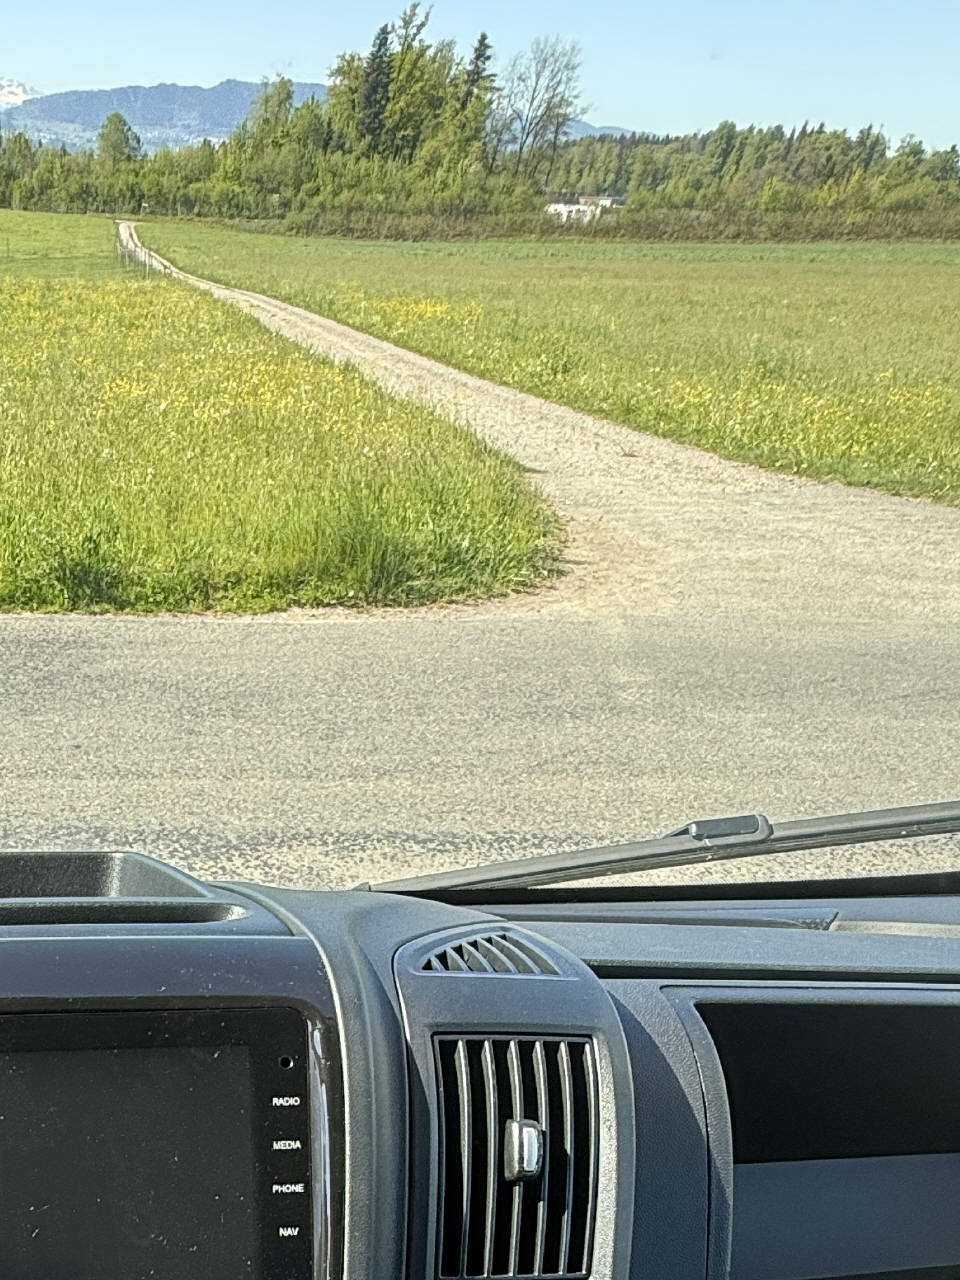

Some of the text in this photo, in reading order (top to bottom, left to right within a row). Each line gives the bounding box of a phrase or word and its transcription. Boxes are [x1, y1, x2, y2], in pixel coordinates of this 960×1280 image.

[272, 1097, 300, 1106] RADIO
[272, 1141, 302, 1150] MEDIA
[272, 1183, 305, 1193] PHONE
[279, 1227, 299, 1237] NAV
